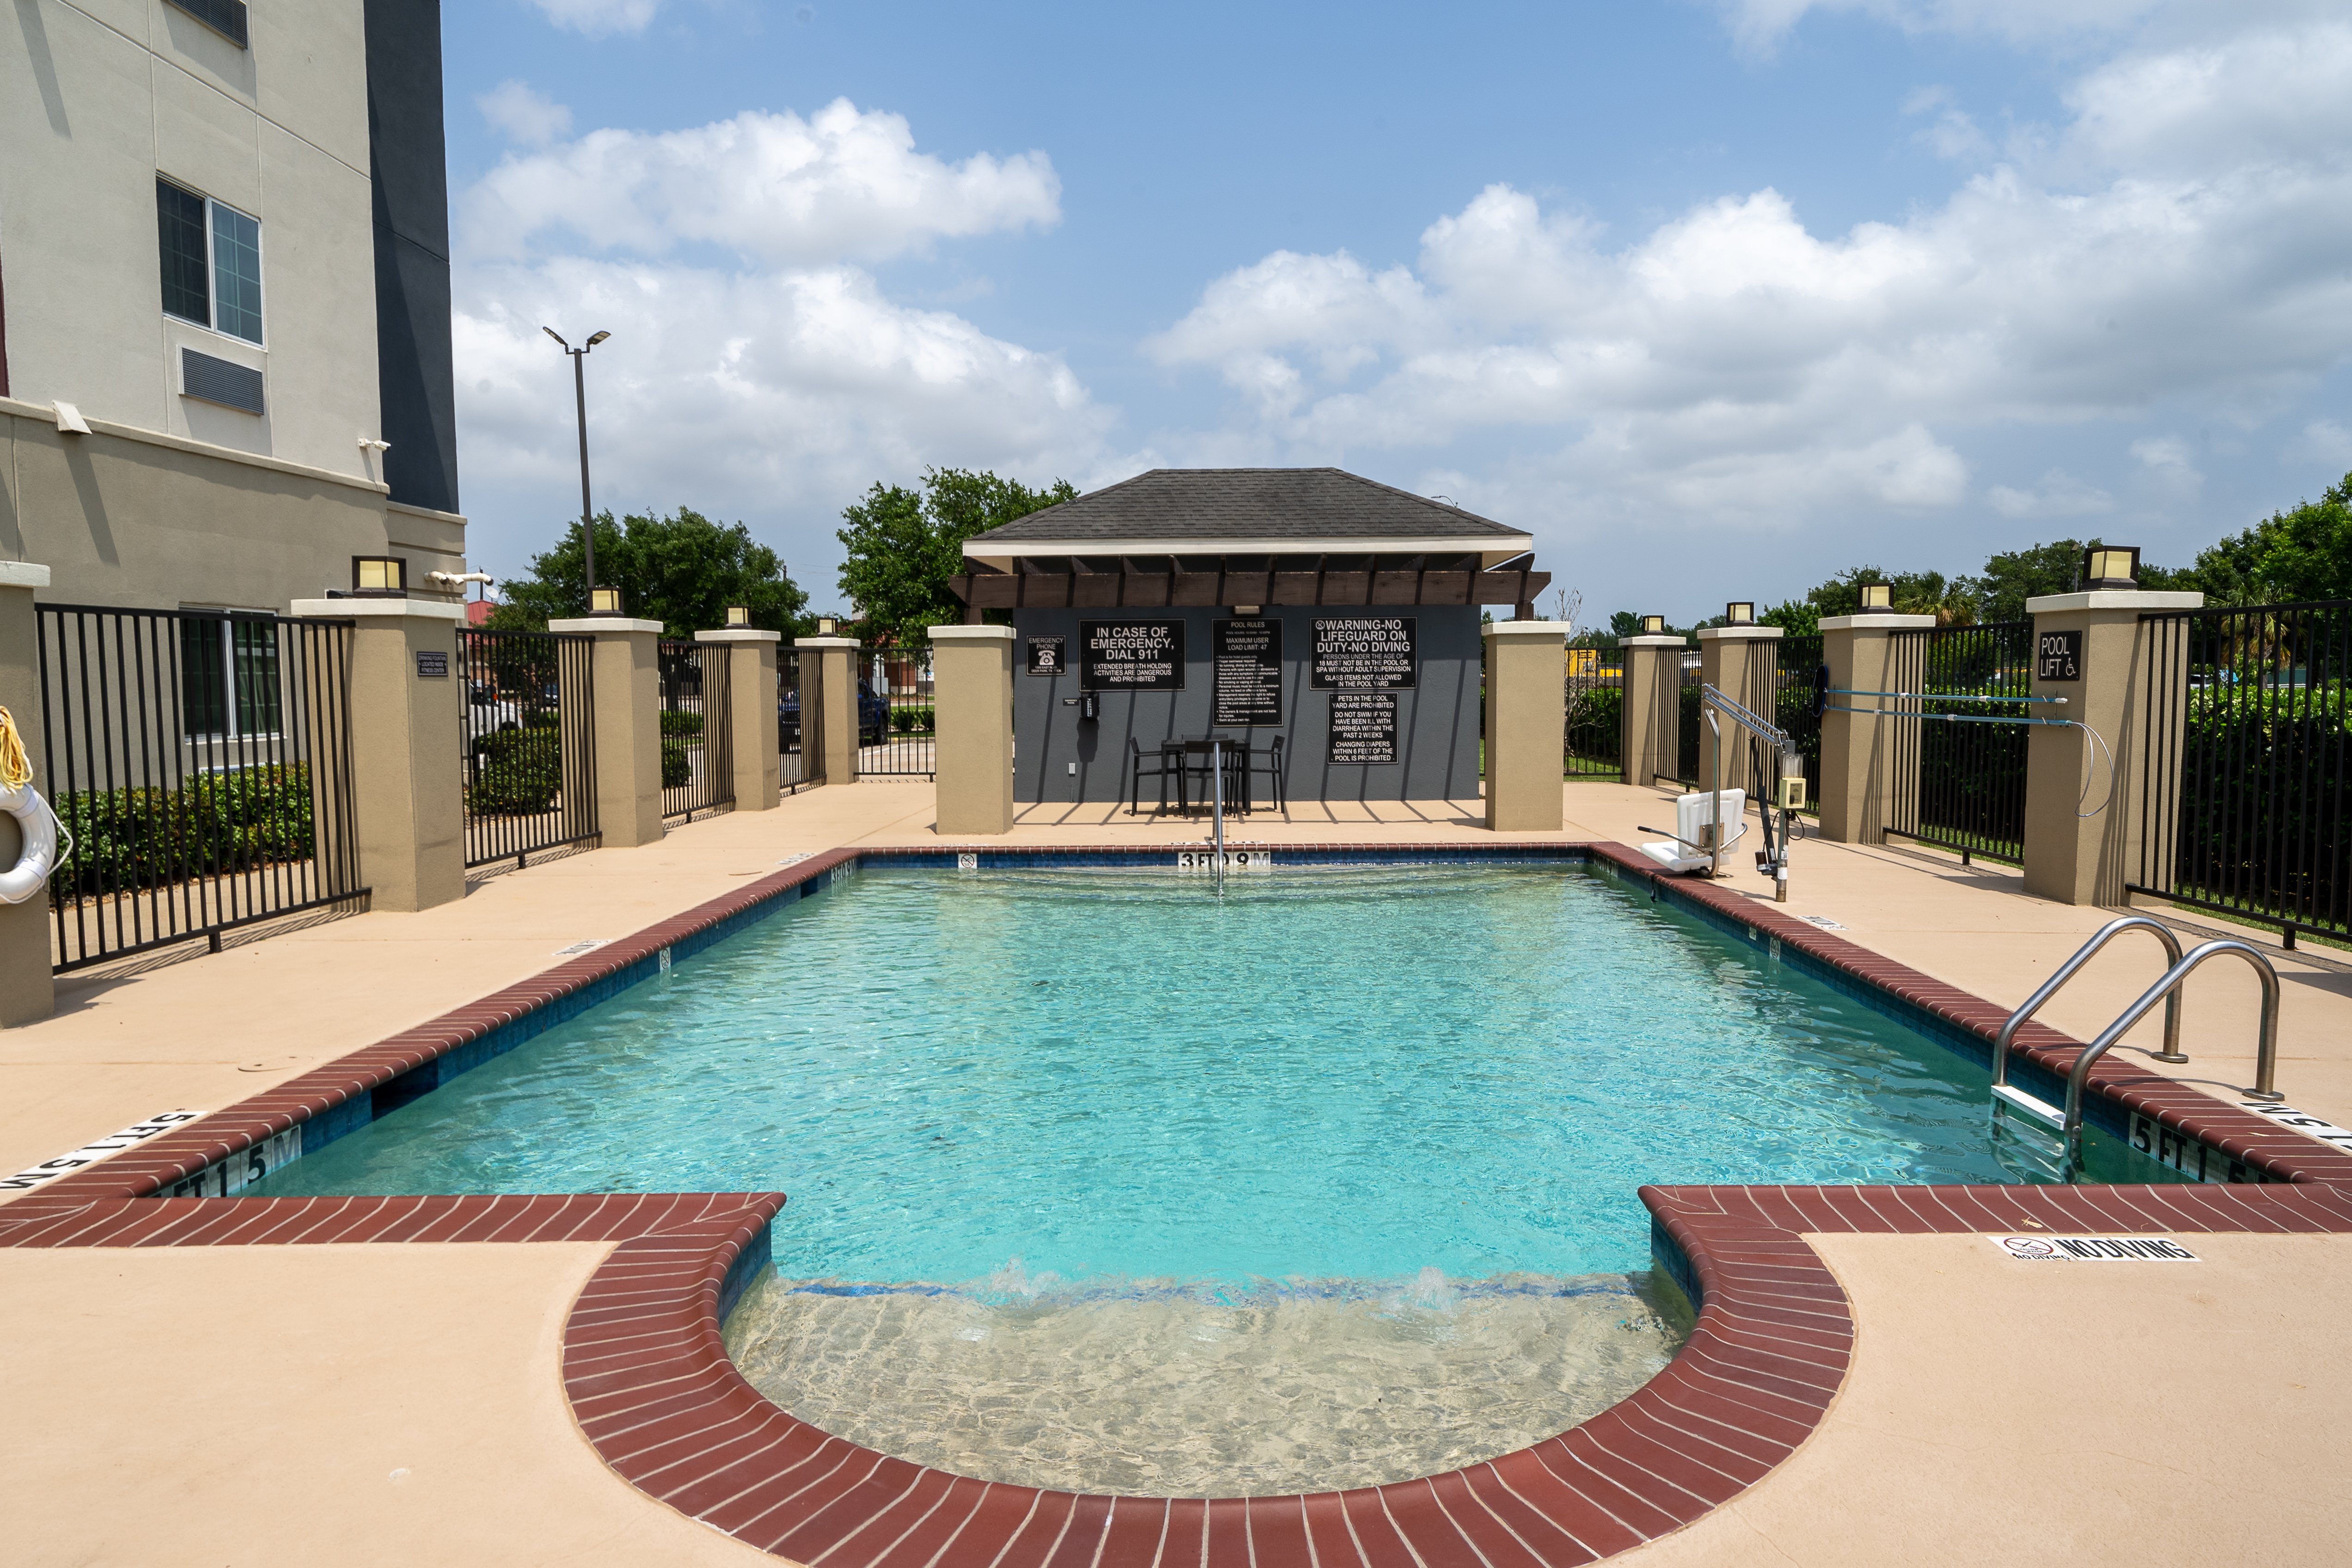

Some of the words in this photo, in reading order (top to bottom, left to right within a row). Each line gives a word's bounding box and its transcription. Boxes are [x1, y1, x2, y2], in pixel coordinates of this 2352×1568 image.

[1326, 620, 1401, 630] WARNING-NO
[1097, 627, 1109, 637] IN
[1113, 627, 1147, 637] CASE
[1151, 627, 1168, 637] OF
[1321, 631, 1386, 641] LIFEGUARD
[1390, 631, 1406, 641] ON
[1091, 638, 1174, 650] EMERGENCY,
[1317, 642, 1368, 653] DUTY-NO
[1372, 642, 1410, 653] DIVING
[2042, 637, 2070, 655] POOL
[1106, 650, 1135, 659] DIAL
[1138, 650, 1158, 659] 911
[2041, 659, 2061, 676] LIFT
[2054, 1239, 2103, 1258] NO
[2089, 1240, 2196, 1258] DIVING
